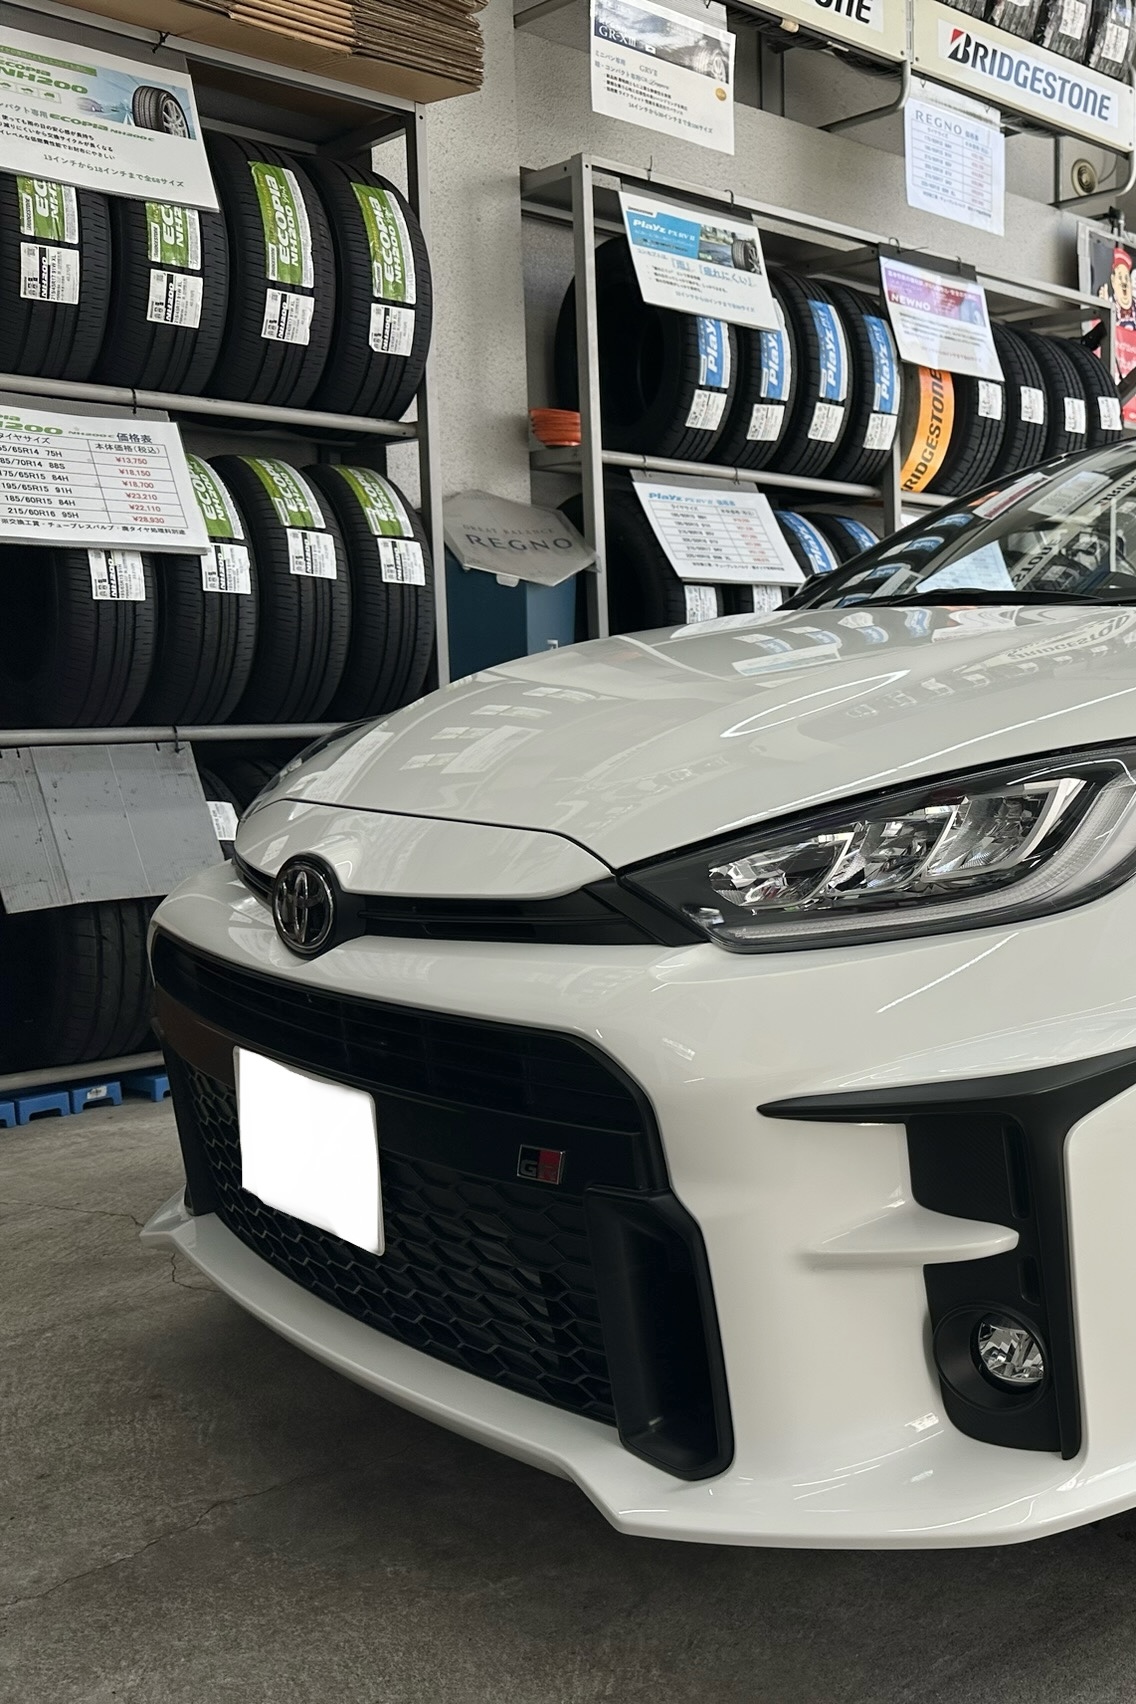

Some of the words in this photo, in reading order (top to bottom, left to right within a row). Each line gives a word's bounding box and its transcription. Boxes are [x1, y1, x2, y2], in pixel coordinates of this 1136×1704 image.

[0, 66, 88, 94] NH200
[947, 28, 1112, 121] BRIDGESTONE
[915, 110, 962, 135] REGNO
[285, 205, 298, 267] NH200
[891, 292, 931, 312] NEWNO
[824, 328, 837, 387] Playz
[879, 343, 891, 401] Playz
[0, 420, 64, 435] 200
[117, 432, 152, 444] 価格表
[901, 368, 944, 492] RIDGESTONE
[47, 448, 63, 458] 75H
[49, 462, 66, 471] 88S
[2, 482, 50, 493] 195/65R15
[55, 485, 73, 495] 91H
[52, 473, 70, 483] 84H
[5, 494, 53, 505] 185/60R15
[58, 498, 76, 507] 84H
[7, 507, 56, 518] 215/60R16
[62, 510, 80, 519] 95H
[465, 534, 573, 551] REGNO
[520, 1159, 558, 1181] GR
